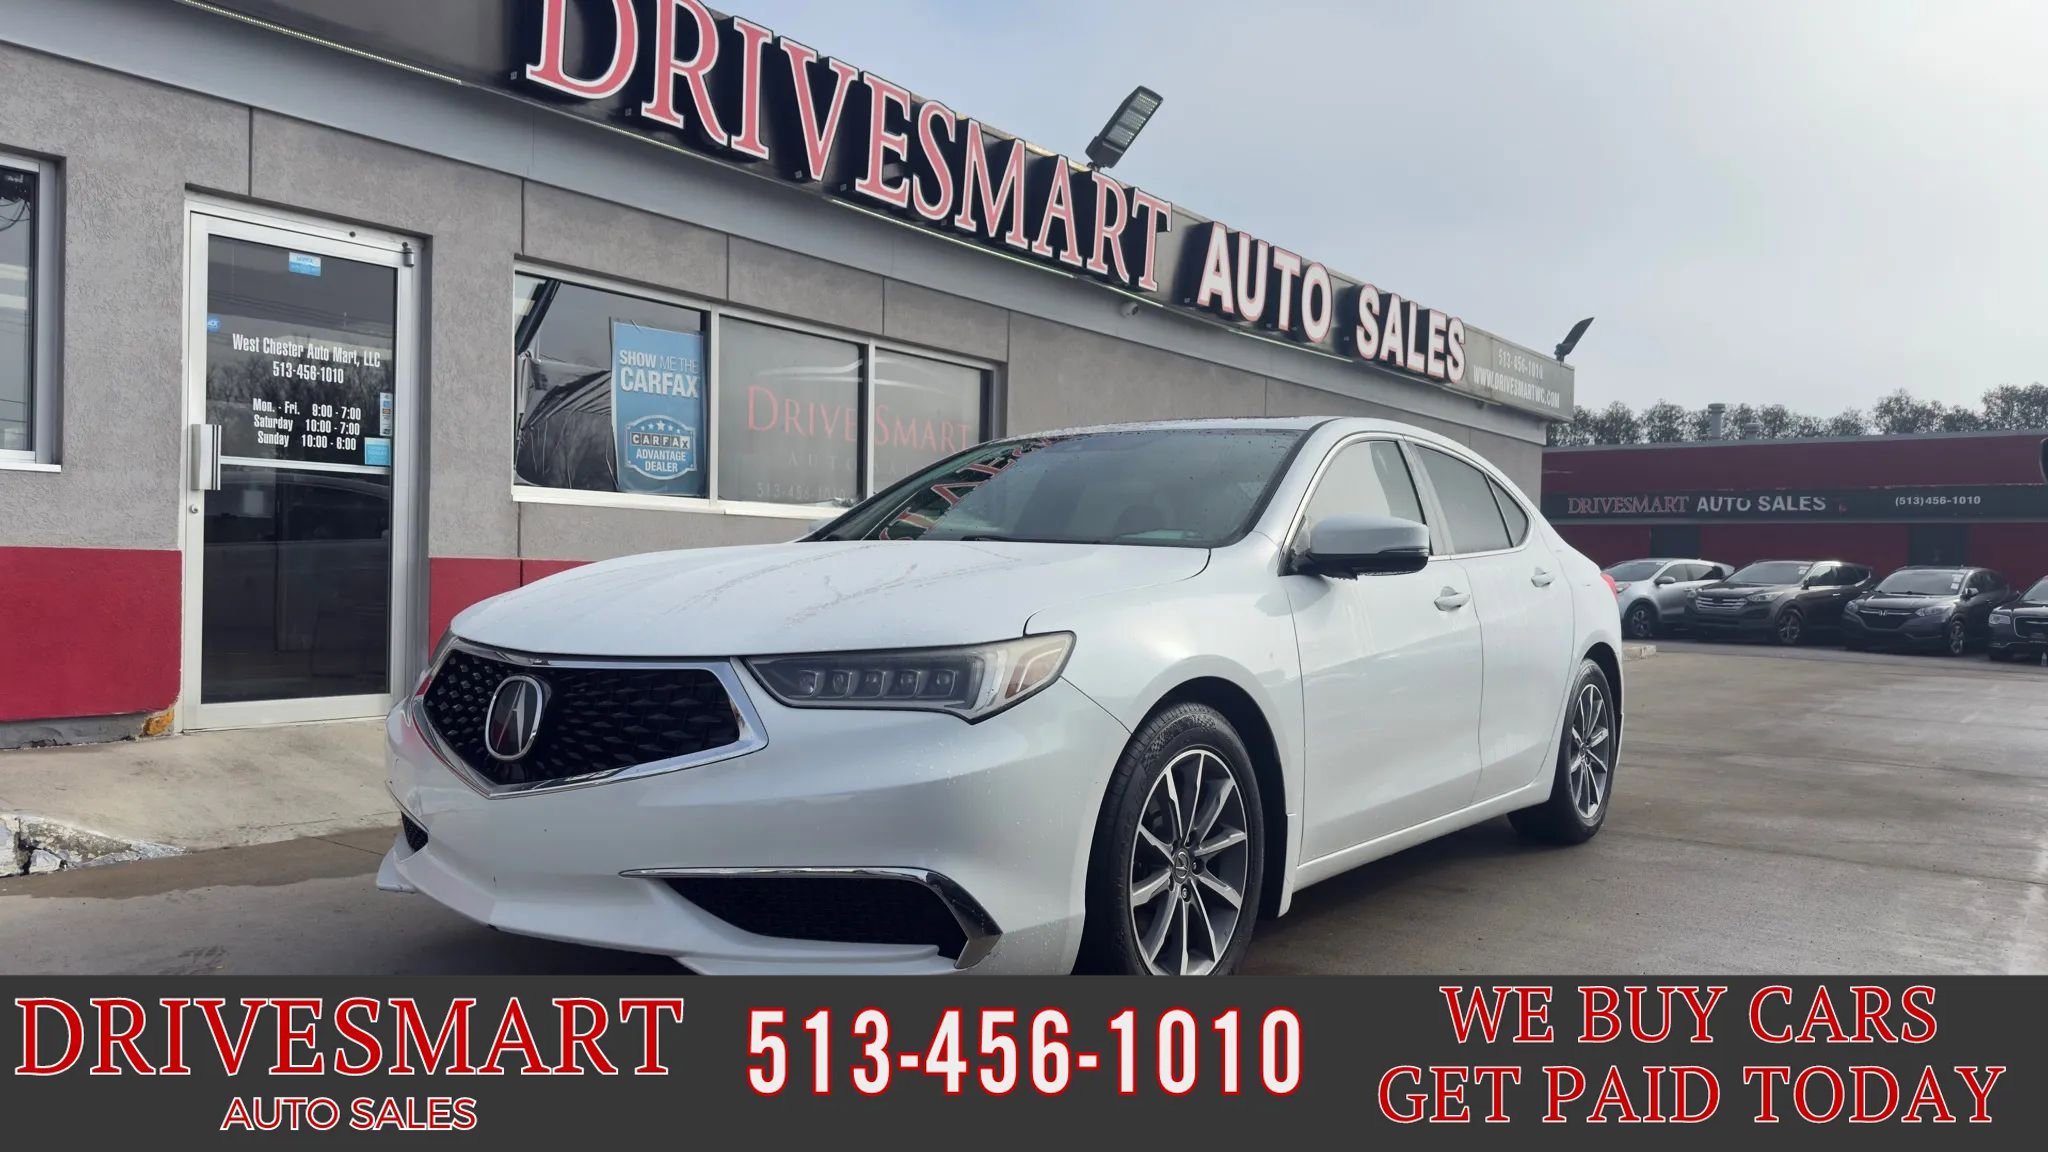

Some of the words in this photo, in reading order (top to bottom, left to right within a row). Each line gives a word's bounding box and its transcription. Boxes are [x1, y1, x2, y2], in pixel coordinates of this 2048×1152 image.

[526, 0, 1172, 292] DRIVESMART
[1197, 221, 1332, 343] AUTO
[1356, 284, 1466, 383] SALES
[232, 333, 260, 353] West
[263, 337, 304, 358] Chester
[307, 343, 329, 361] Auto
[332, 346, 360, 368] Mart,
[363, 349, 381, 368] LLC
[619, 349, 657, 368] SHOW
[660, 355, 676, 371] ME
[679, 358, 698, 374] THE
[273, 361, 344, 384] 513-456-1010
[620, 366, 699, 398] CARFAX
[1473, 364, 1560, 408] WWW.DRIVESMARTWC.COM
[252, 398, 275, 413] Mon.
[284, 401, 300, 415] Fri.
[312, 403, 333, 418] 9:00
[341, 406, 361, 420] 7:00
[253, 414, 294, 432] Saturday
[305, 419, 332, 433] 10:00
[340, 421, 360, 436] 7:00
[257, 430, 290, 448] Sunday
[302, 434, 328, 449] 10:00
[632, 433, 691, 449] CARFAX
[636, 448, 686, 462] ADVANTAGE
[645, 460, 678, 473] DEALER
[1567, 495, 1690, 514] DRIVESMART
[1697, 496, 1751, 512] AUTO
[1758, 496, 1827, 512] SALES
[1895, 496, 1981, 507] (513)456-1010
